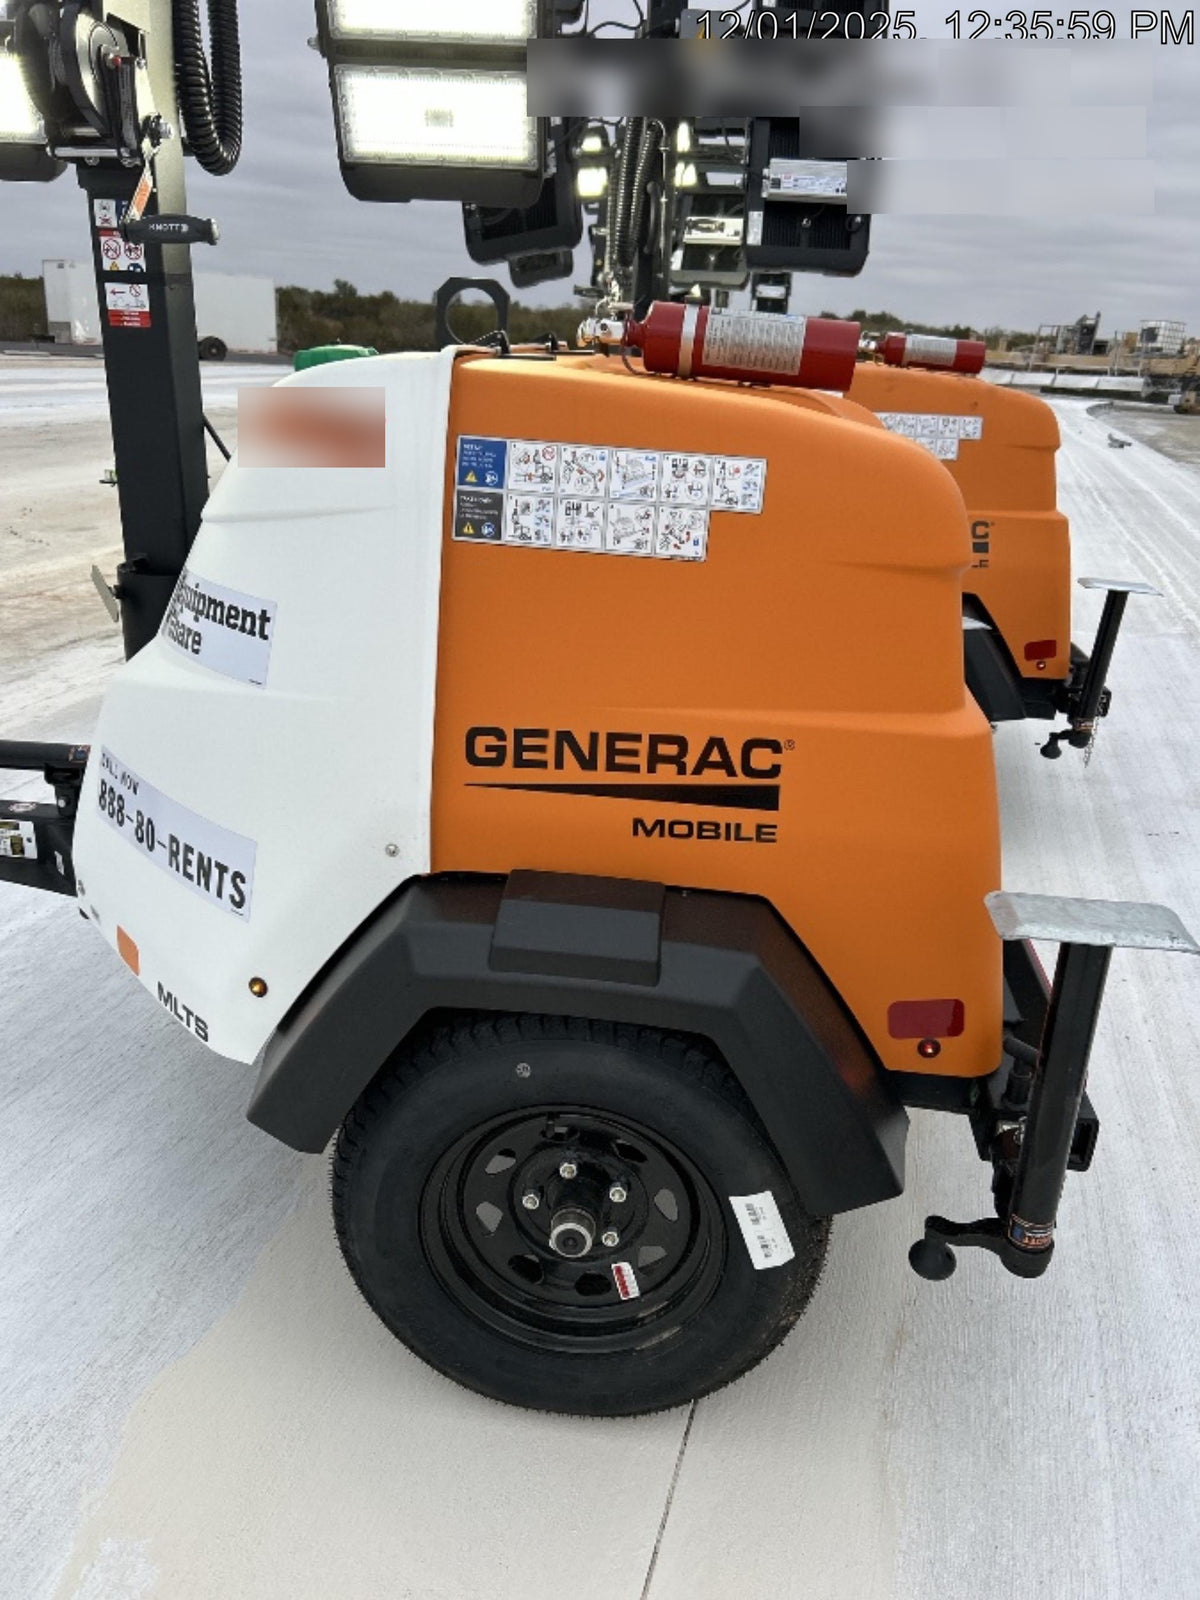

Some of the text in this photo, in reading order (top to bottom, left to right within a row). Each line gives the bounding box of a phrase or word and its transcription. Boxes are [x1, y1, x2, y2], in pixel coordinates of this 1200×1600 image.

[464, 726, 784, 779] GENERAC
[98, 777, 247, 909] 888-80-RENTS
[632, 817, 778, 843] MOBILE
[157, 980, 209, 1042] MLTS
